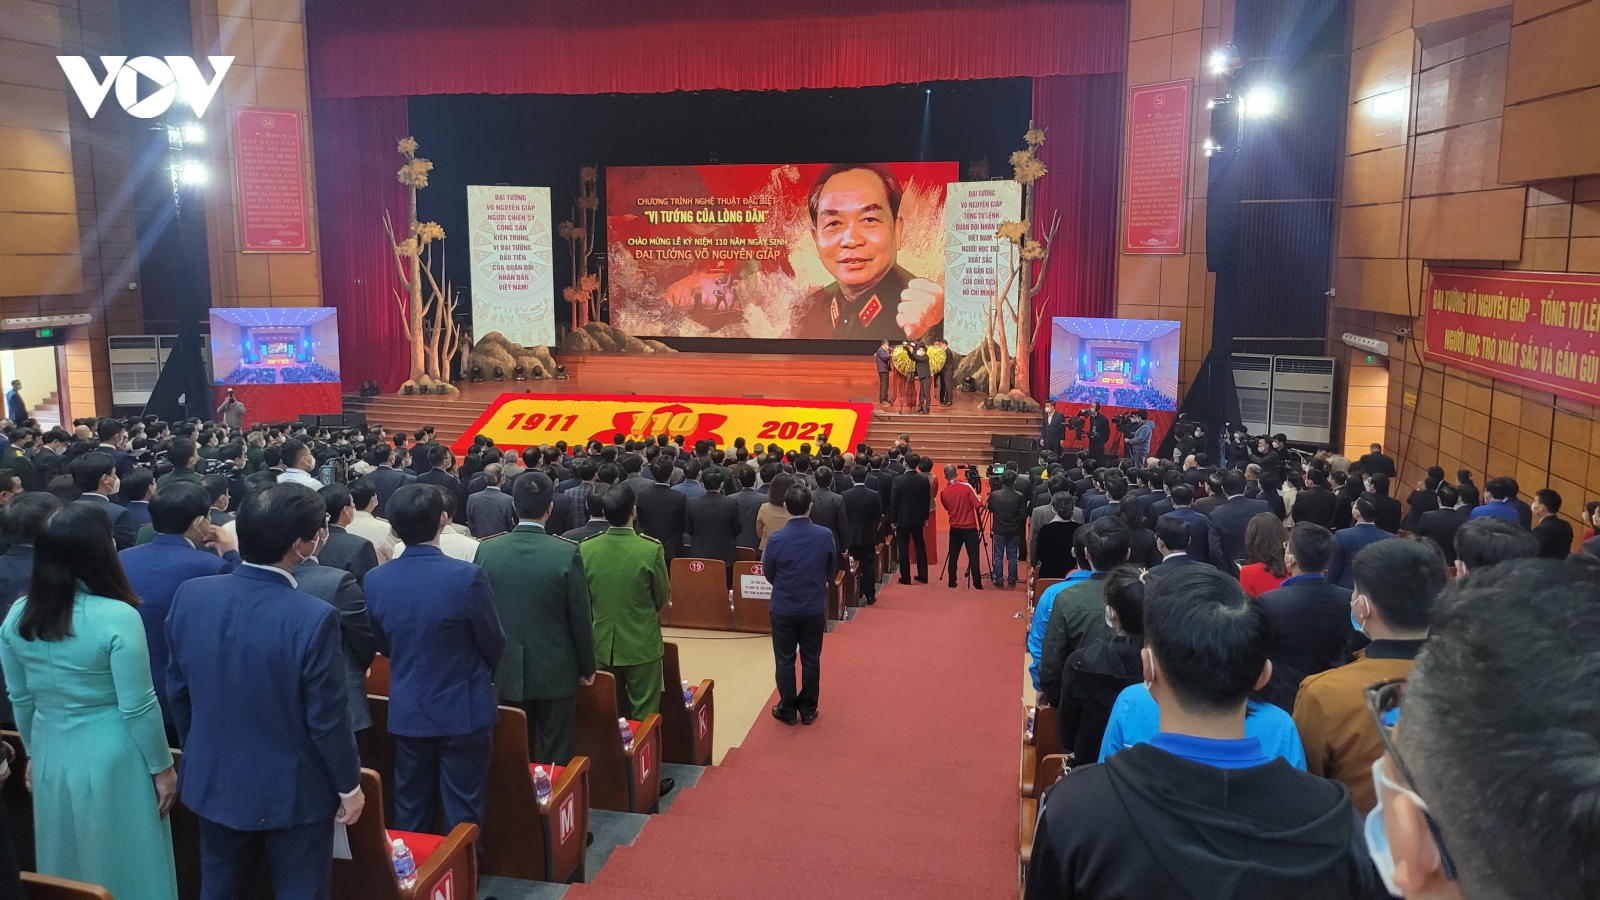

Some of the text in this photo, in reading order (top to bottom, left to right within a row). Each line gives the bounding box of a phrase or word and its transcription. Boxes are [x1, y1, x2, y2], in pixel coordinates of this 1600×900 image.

[969, 191, 977, 199] ĐẠI
[671, 196, 692, 205] TRÌNH
[695, 196, 714, 206] NGHỆ
[717, 196, 740, 206] THUẬT
[742, 196, 758, 206] ĐẶC
[661, 210, 693, 223] TƯỚNG
[696, 209, 715, 223] CỦA
[718, 209, 742, 223] LÒNG
[964, 211, 977, 219] TỔNG
[986, 212, 1000, 220] LỆNH
[497, 224, 513, 232] CỘNG
[971, 224, 979, 232] ĐỘI
[628, 238, 647, 246] CHÀO
[650, 238, 671, 246] MỪNG
[673, 237, 681, 246] LỄ
[695, 237, 712, 247] NIỆM
[730, 237, 746, 246] NĂM
[748, 237, 767, 246] NGÀY
[968, 234, 978, 243] VIỆT
[635, 248, 780, 261] ĐẠI TƯỚNG VÕ NGUYÊN GIÁP
[978, 246, 988, 254] HỌC
[968, 254, 992, 263] XUẤT SẮC
[524, 263, 534, 272] ĐỘI
[966, 266, 972, 274] VÀ
[974, 265, 984, 274] GẦN
[499, 283, 511, 292] VIỆT
[963, 287, 969, 295] HỒ
[1433, 289, 1444, 314] ĐẠI
[1445, 286, 1466, 314] TƯỚNG
[1467, 288, 1477, 315] VÕ
[1477, 291, 1509, 320] NGUYÊN
[1510, 292, 1530, 322] GIÁP
[1540, 289, 1566, 328] TỔNG
[1568, 298, 1583, 329] TƯ
[1444, 326, 1599, 384] NGƯỜI HỌC TRÒ XUẤT SẮC VÀ GẦN GŨI
[506, 413, 579, 431] 1911
[631, 412, 699, 436] 110
[757, 421, 833, 440] 2021
[700, 710, 707, 734] K
[642, 755, 649, 782] L
[562, 798, 574, 843] M
